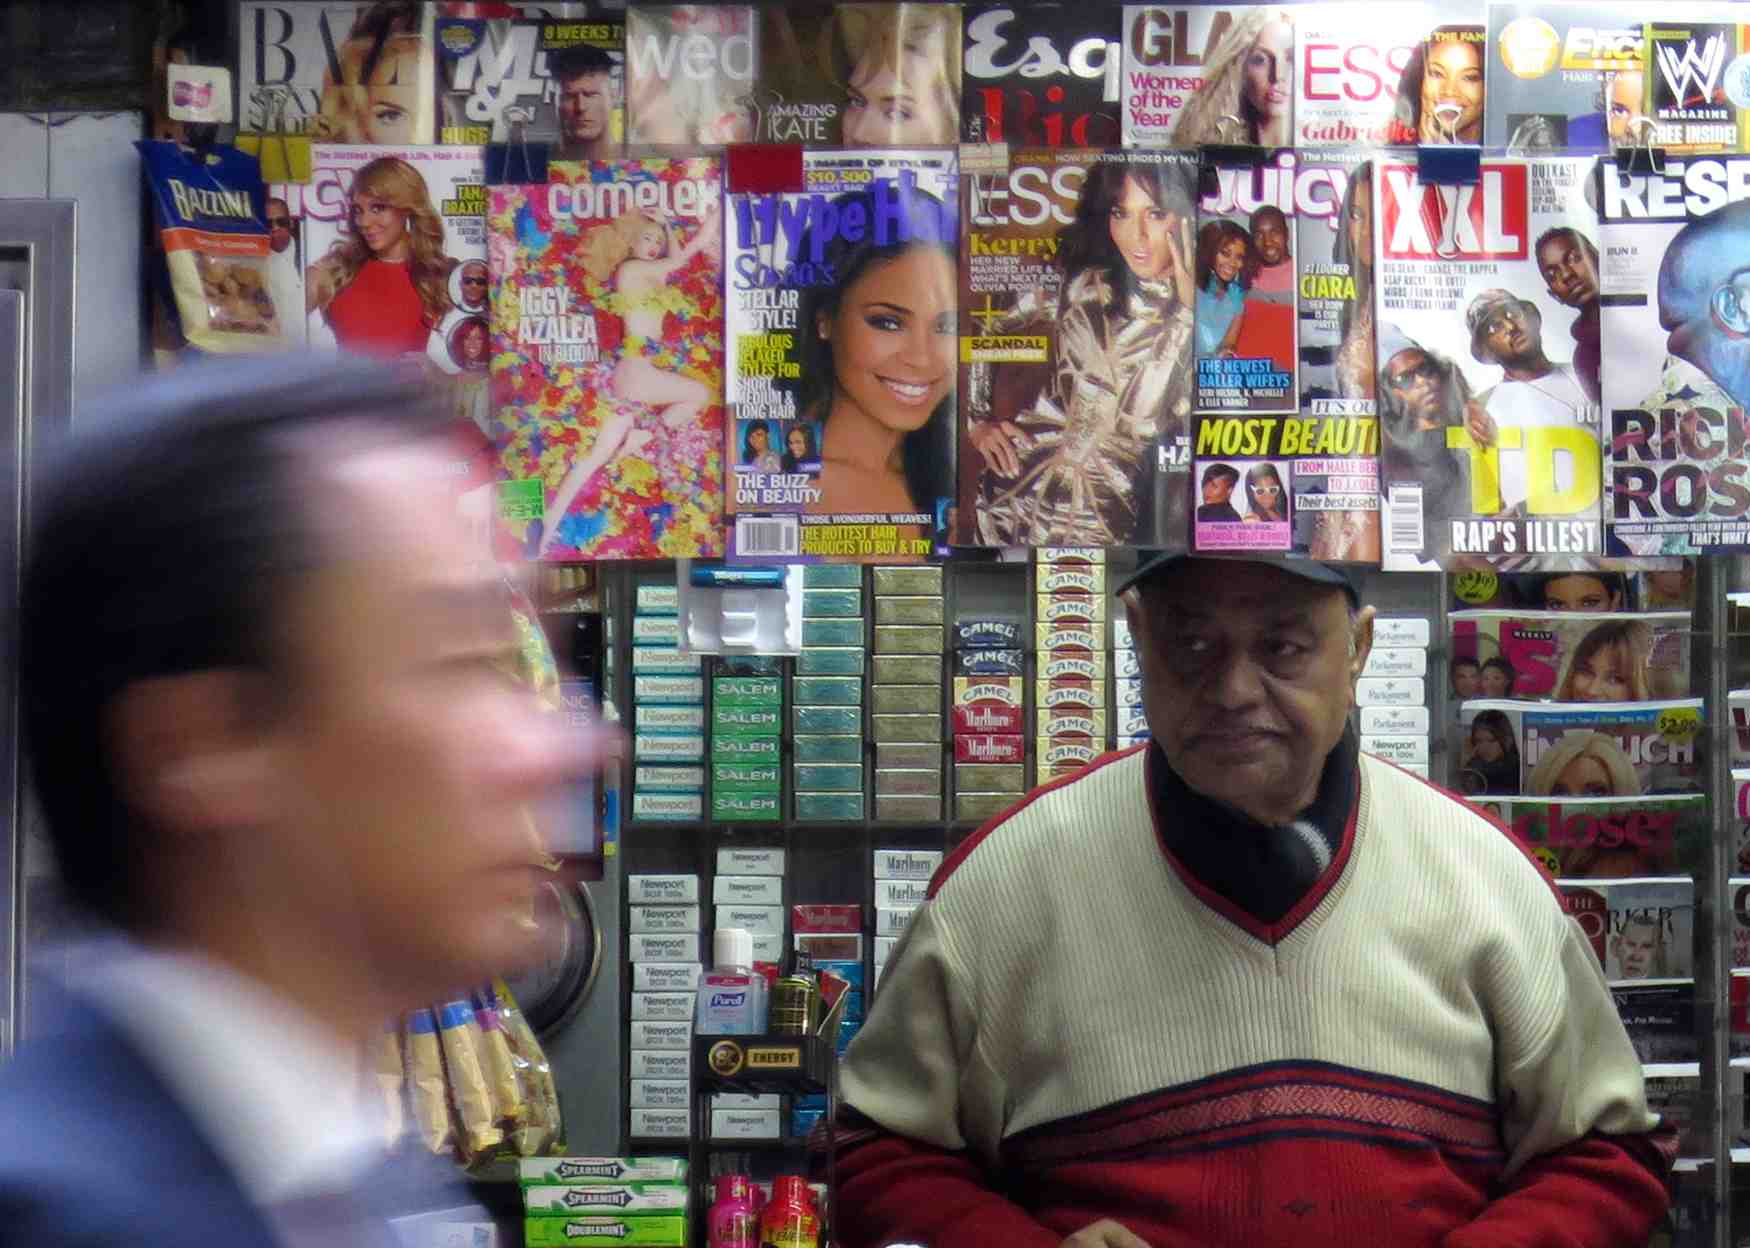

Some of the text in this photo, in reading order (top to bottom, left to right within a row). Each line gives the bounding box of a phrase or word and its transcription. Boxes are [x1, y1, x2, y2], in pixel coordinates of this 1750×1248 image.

[965, 9, 1121, 102] Esq
[1130, 73, 1213, 90] Women
[1130, 92, 1182, 109] of the
[768, 104, 837, 118] AMAZING
[1130, 109, 1171, 127] Year
[1659, 110, 1728, 119] MAGAZINE
[767, 119, 830, 141] KATE
[970, 233, 1058, 261] Kerry
[1301, 276, 1356, 299] CIARA
[519, 288, 569, 315] IGGY
[519, 316, 598, 344] AZALEA
[971, 338, 1044, 351] SCANDAL
[1199, 359, 1271, 373] THE NEWEST
[1199, 373, 1246, 387] BALLER
[1196, 419, 1277, 455] MOST
[736, 473, 809, 489] THE BUZZ
[736, 489, 822, 504] ON BEAUTY
[1452, 521, 1596, 552] RAP'S ILLEST
[1721, 531, 1745, 545] WHAT
[1045, 575, 1095, 592] CAMEL
[960, 623, 1016, 641] CAMEL
[1045, 633, 1095, 651] CAMEL
[716, 682, 777, 697] SALEM
[963, 685, 1016, 705] CAMEL
[716, 797, 776, 812] SALEM
[640, 879, 685, 890] Newport
[646, 968, 690, 977] Newport
[642, 1056, 687, 1066] Newport
[560, 1163, 619, 1178] SPEARMINT
[566, 1223, 625, 1238] DOUBLEMINT
